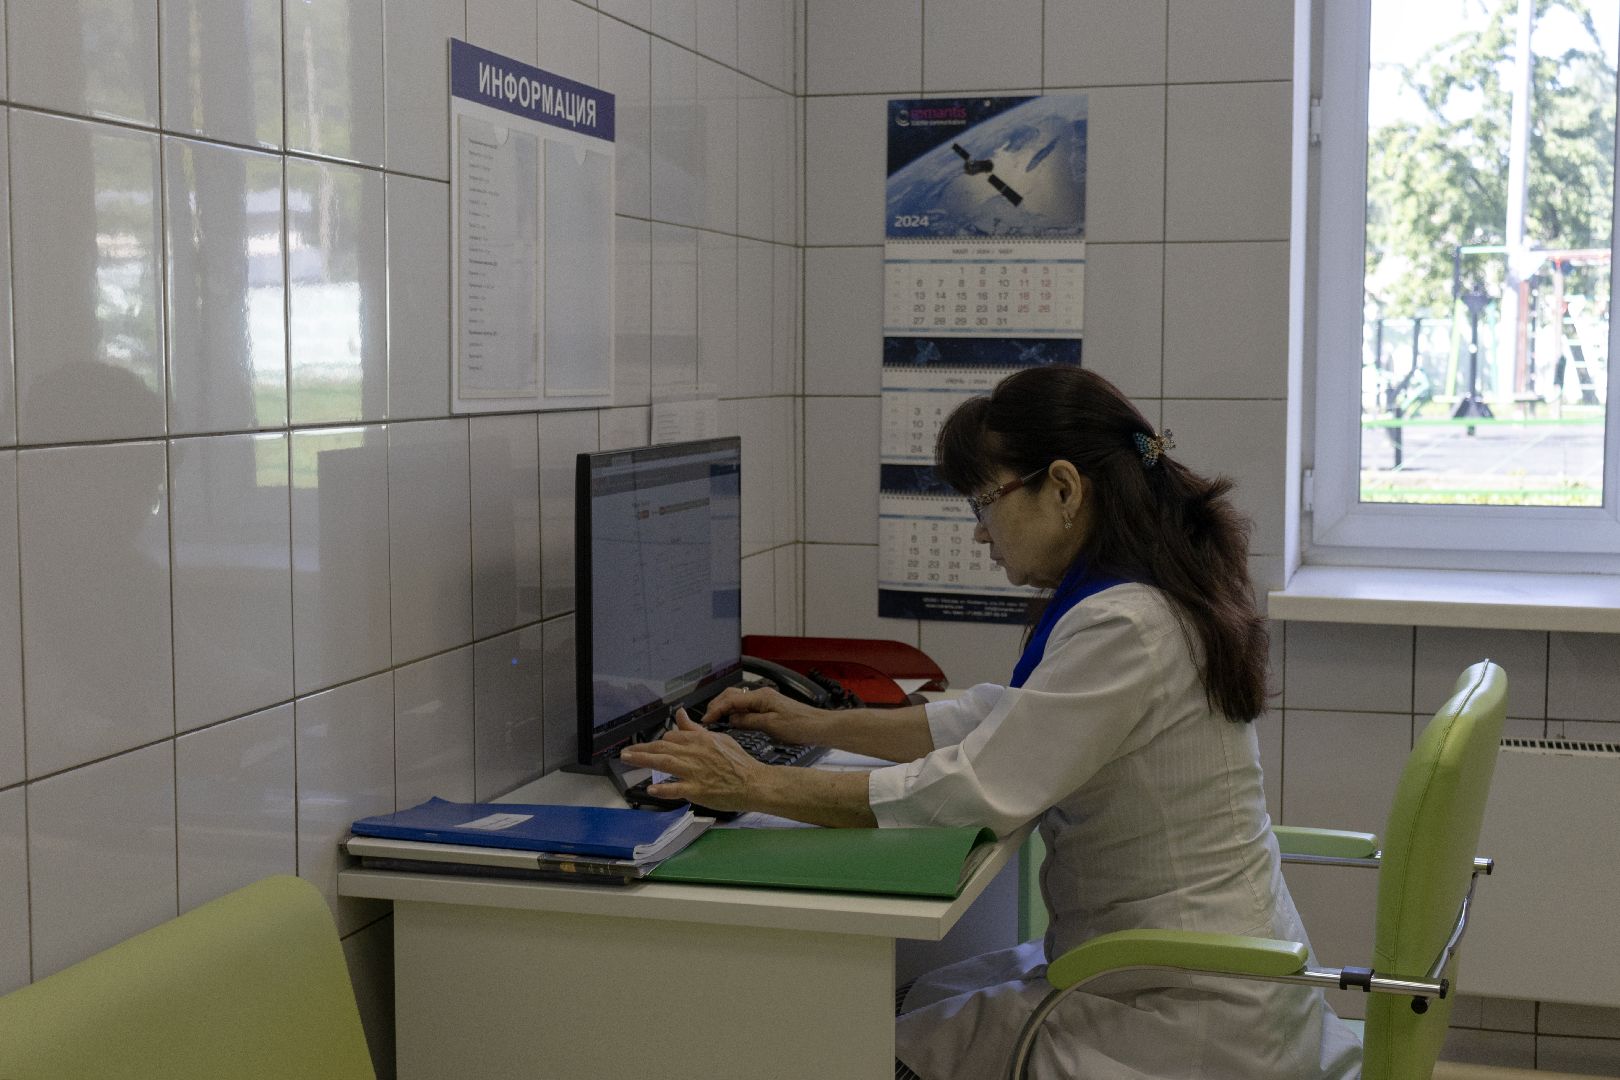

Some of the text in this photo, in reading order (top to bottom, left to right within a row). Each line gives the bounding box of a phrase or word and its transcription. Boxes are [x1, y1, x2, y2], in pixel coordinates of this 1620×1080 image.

[479, 62, 597, 128] ИНФОРМАЦИЯ
[894, 215, 930, 228] 2024
[959, 266, 964, 274] 1
[979, 266, 986, 275] 2
[1000, 266, 1007, 275] 3
[916, 279, 923, 287] 6
[938, 279, 944, 287] 7
[958, 279, 965, 288] 8
[998, 279, 1010, 287] 10
[1019, 279, 1029, 287] 11
[1040, 279, 1051, 288] 12
[914, 291, 926, 300] 13
[956, 292, 967, 300] 15
[998, 291, 1009, 300] 17
[1040, 291, 1052, 300] 19
[913, 304, 1050, 313] 20 21 22 23 24 25 26
[912, 316, 1007, 326] 27 28 29 30 31
